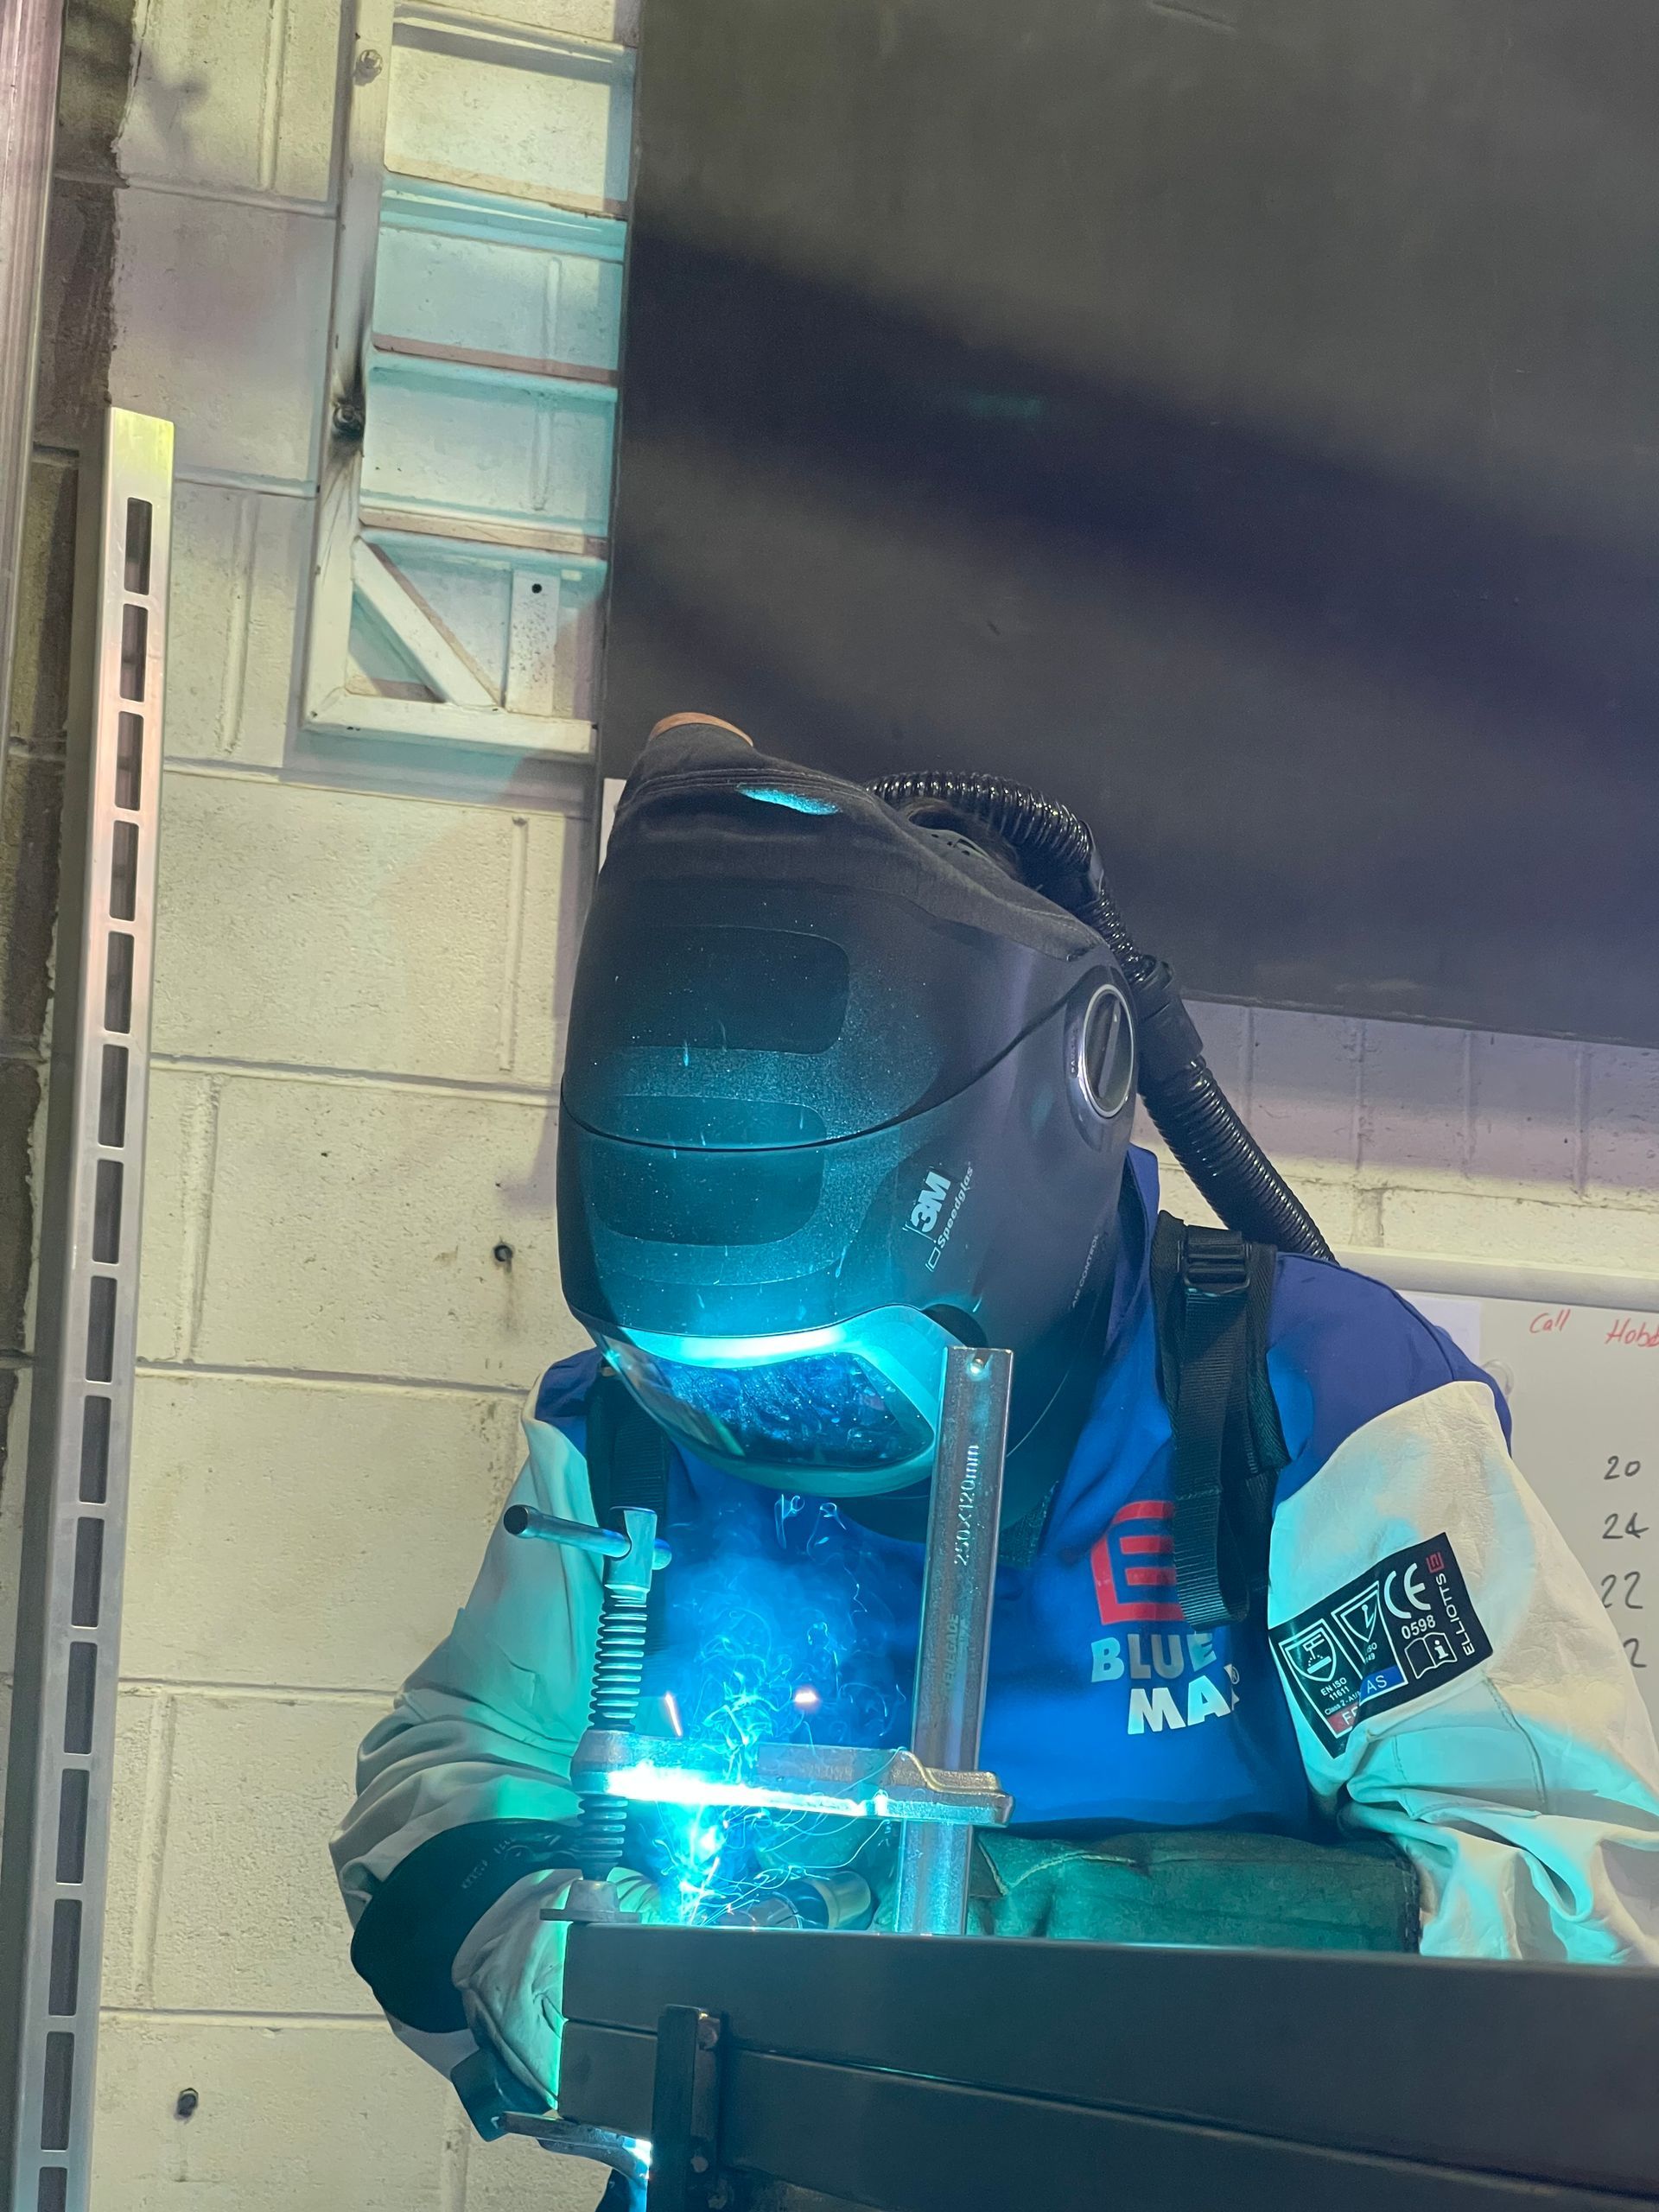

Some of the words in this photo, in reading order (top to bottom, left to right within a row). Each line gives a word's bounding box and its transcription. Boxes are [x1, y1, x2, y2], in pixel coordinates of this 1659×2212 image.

[911, 1171, 951, 1233] 3M
[938, 1166, 974, 1249] Speedglas
[1529, 1308, 1571, 1333] Call
[1604, 1455, 1641, 1480] 20
[1601, 1571, 1643, 1610] 22
[1402, 1614, 1436, 1640] 0598
[1435, 1573, 1476, 1656] ELLIOTTS
[1090, 1633, 1217, 1682] BLUE
[1320, 1685, 1333, 1696] EN
[1332, 1677, 1347, 1689] ISO
[1329, 1686, 1350, 1700] 11611
[1367, 1675, 1388, 1694] AS
